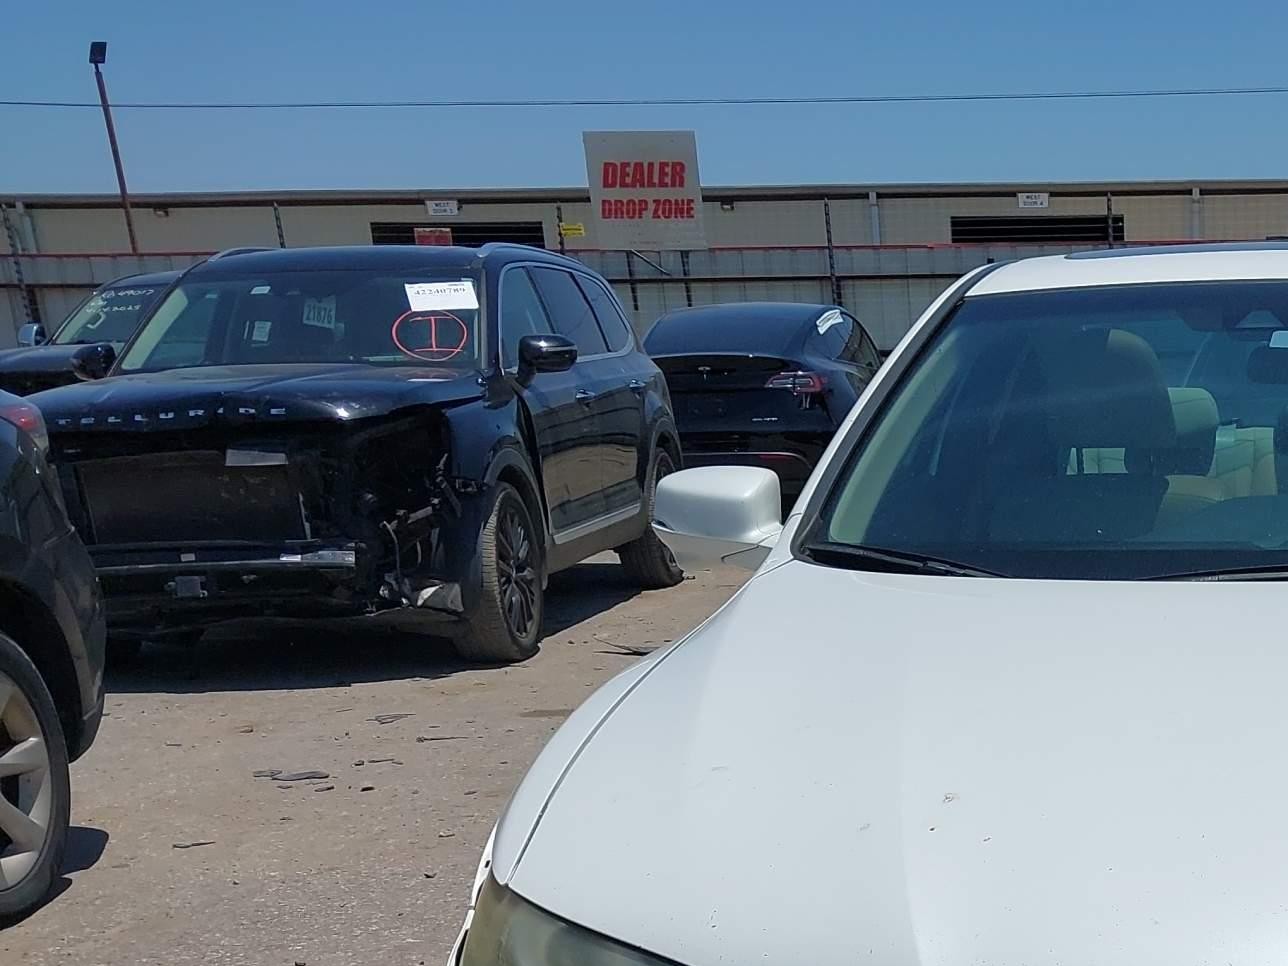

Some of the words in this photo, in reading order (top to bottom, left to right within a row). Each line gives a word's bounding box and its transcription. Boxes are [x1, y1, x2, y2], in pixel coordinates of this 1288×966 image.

[602, 161, 686, 188] DEALER
[601, 199, 648, 219] DROP
[652, 199, 695, 219] ZONE
[306, 303, 333, 324] 21876
